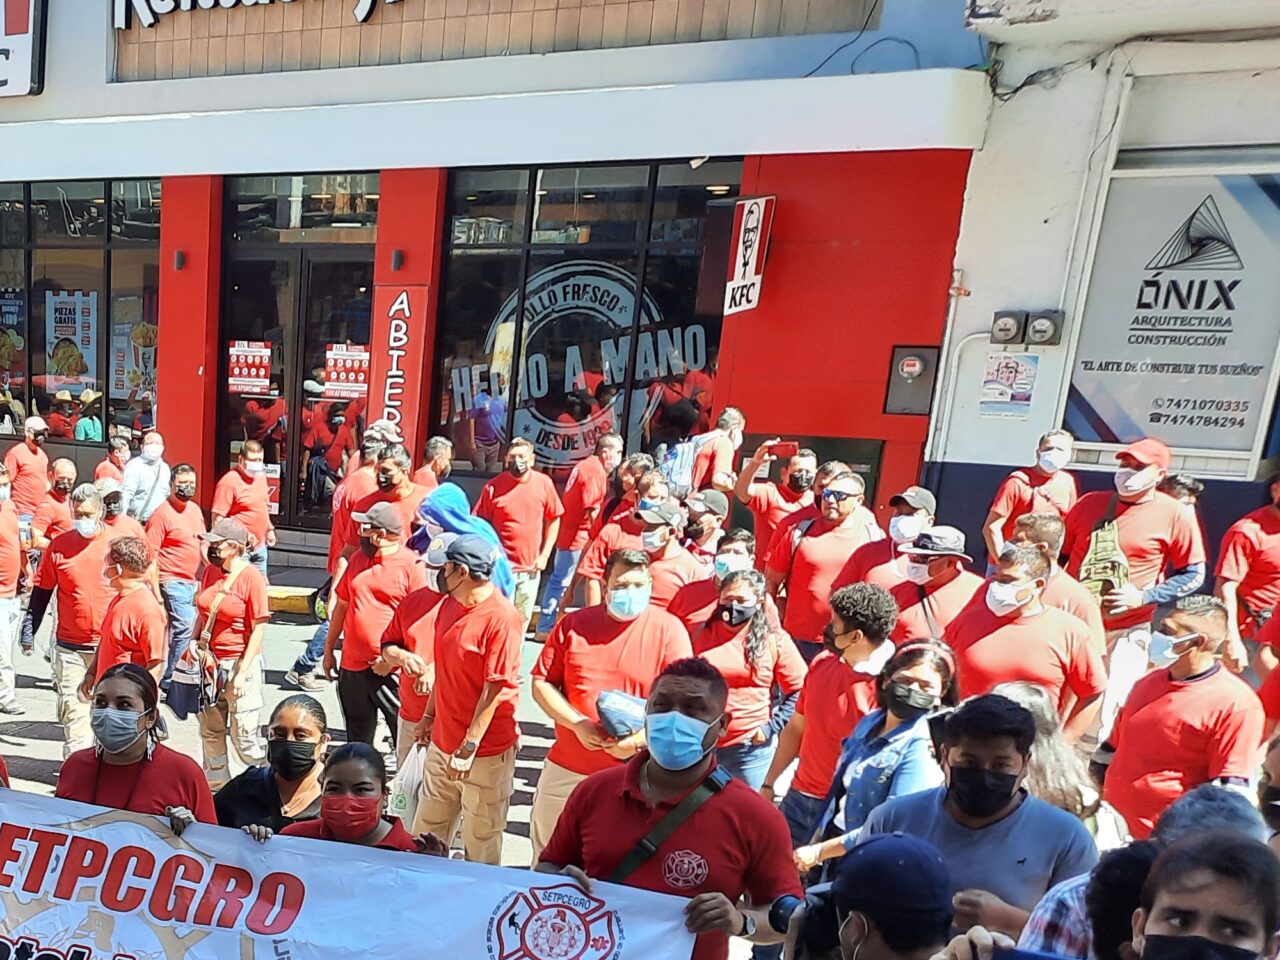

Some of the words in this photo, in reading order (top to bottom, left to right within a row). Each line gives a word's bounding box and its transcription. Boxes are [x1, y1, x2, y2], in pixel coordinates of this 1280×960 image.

[728, 282, 756, 309] KFC
[1136, 272, 1242, 311] ÓNIX
[54, 307, 76, 316] PIEZAS
[525, 289, 556, 323] OLLO
[562, 284, 619, 313] FRESCO
[54, 316, 76, 325] GRATIS
[1130, 316, 1233, 327] ARQUITECTURA
[1127, 333, 1228, 346] CONSTRUCCIÓN
[384, 290, 411, 434] ABIER
[564, 345, 587, 393] A
[600, 324, 707, 387] MANO
[1096, 361, 1122, 371] ARTE
[1124, 362, 1138, 372] DE
[1140, 362, 1195, 374] CONSTRUIR
[1198, 364, 1218, 375] TUS
[1166, 398, 1250, 412] 7471070335
[1162, 413, 1245, 428] 7474784294
[535, 428, 580, 451] DESDE
[541, 890, 592, 911] SETPCEGRO
